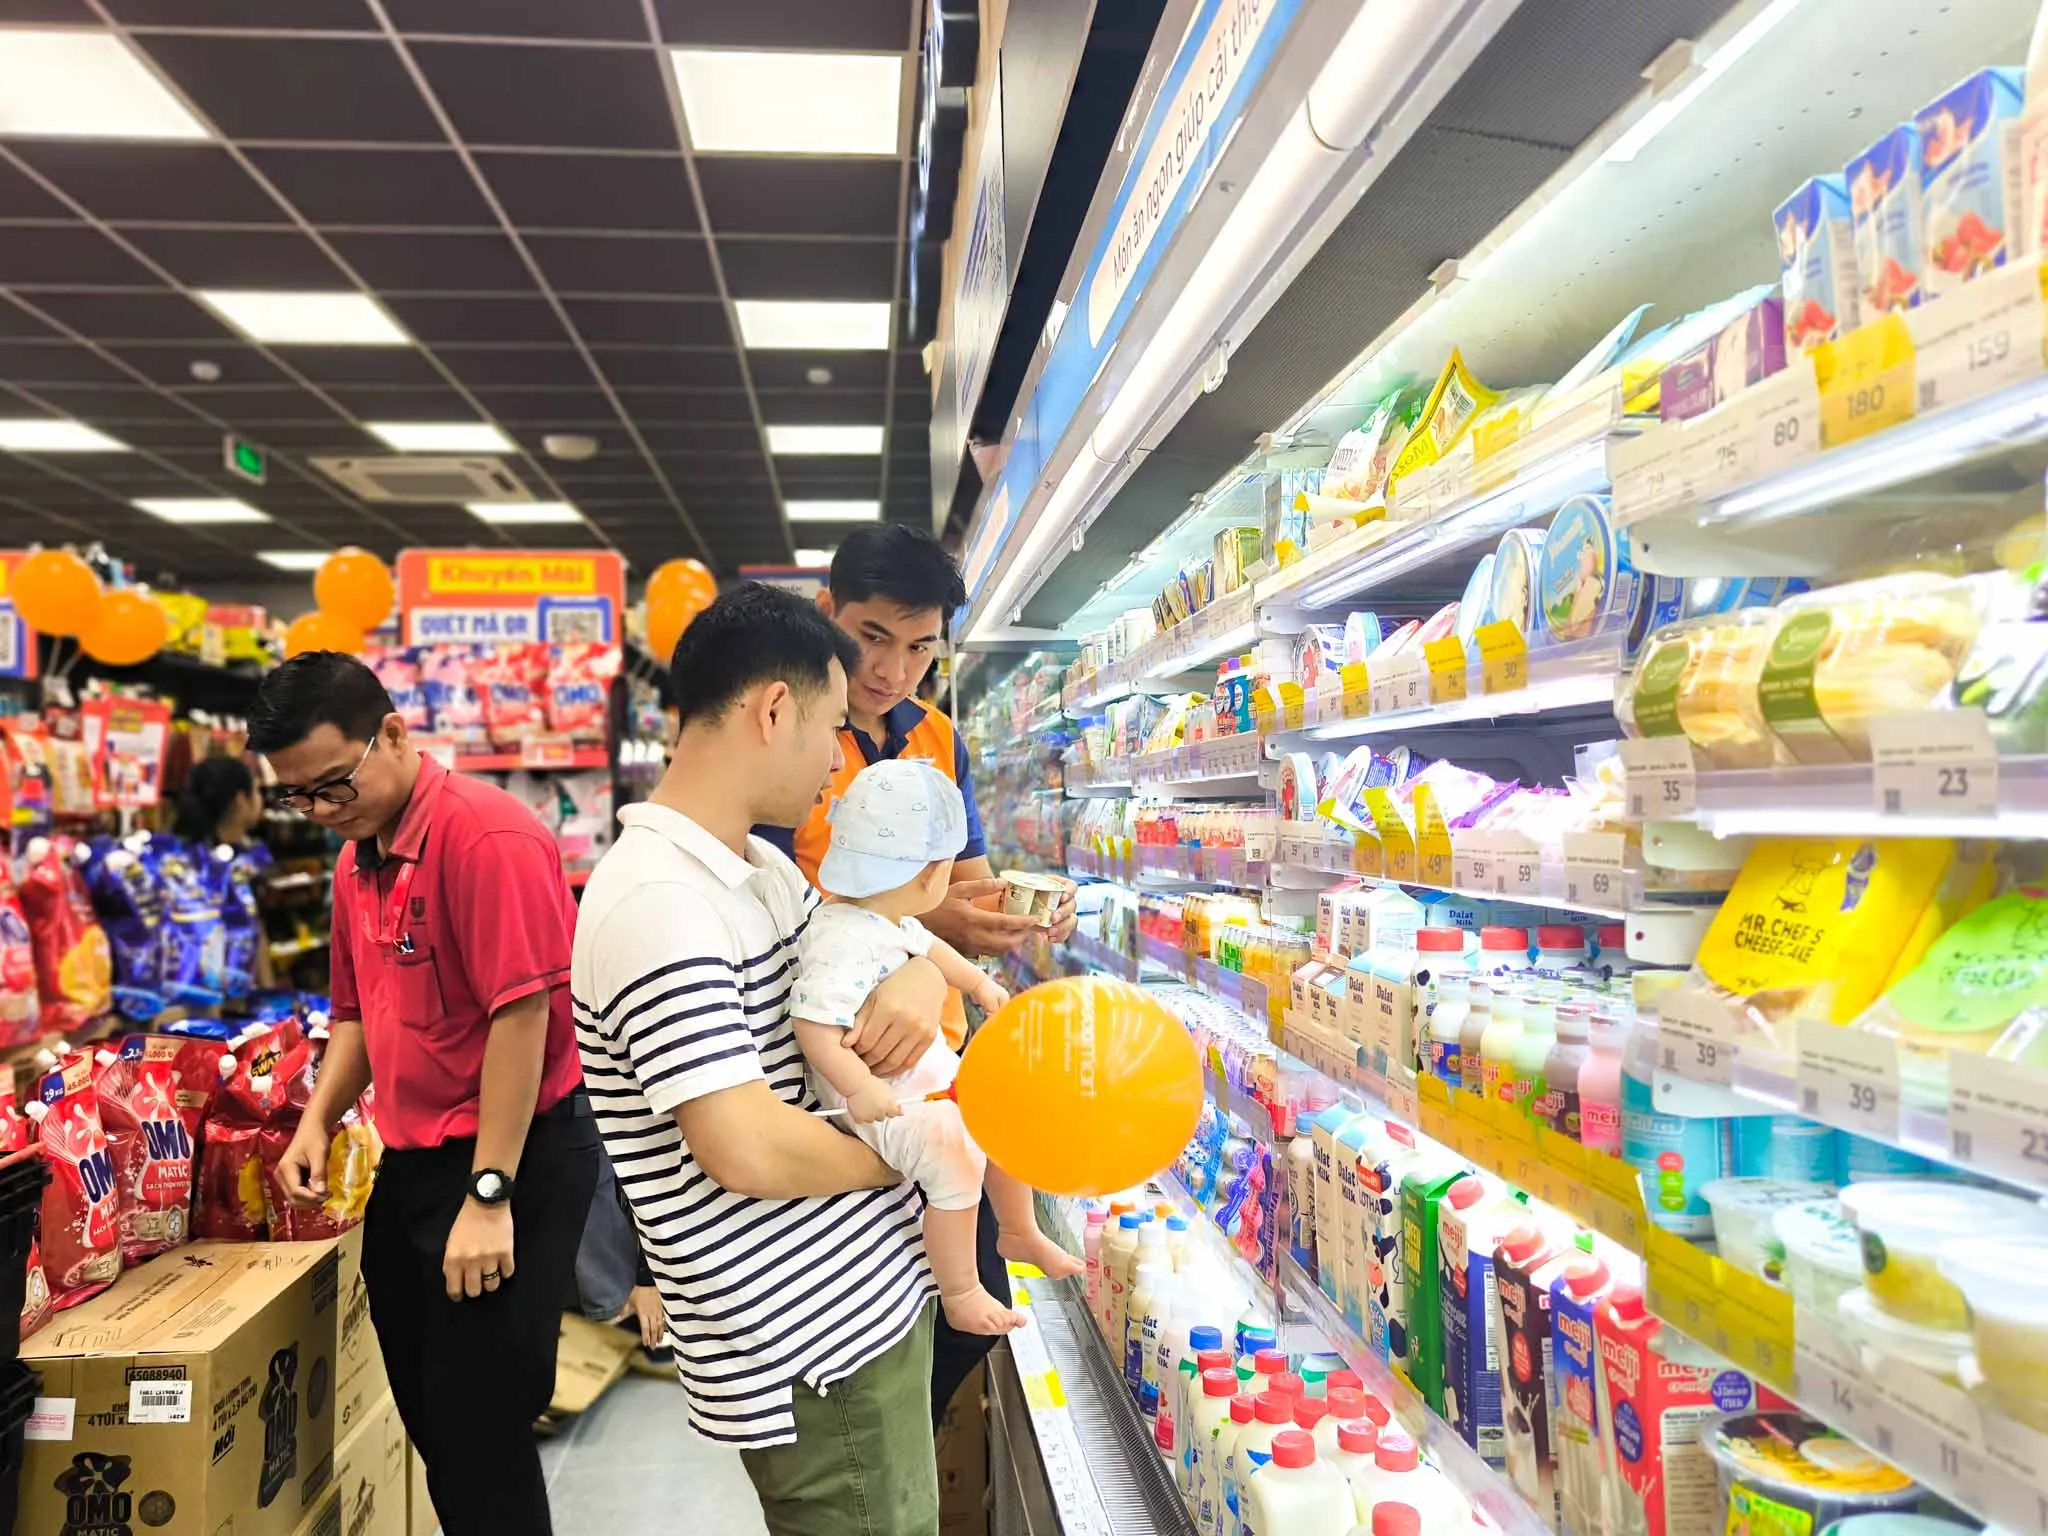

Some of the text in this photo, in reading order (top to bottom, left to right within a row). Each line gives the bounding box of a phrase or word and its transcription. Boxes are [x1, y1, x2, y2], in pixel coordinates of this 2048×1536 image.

[1133, 211, 1145, 249] ăn
[1146, 151, 1174, 219] ngon
[1176, 90, 1205, 174] giúp
[1967, 329, 2011, 371] 159
[1846, 384, 1885, 421] 180
[1773, 416, 1800, 448] 80
[1503, 660, 1518, 680] 30
[1408, 681, 1417, 697] 81
[1662, 780, 1681, 802] 35
[1938, 767, 1969, 797] 23
[1393, 850, 1406, 870] 49
[1427, 854, 1442, 875] 49
[1473, 861, 1485, 879] 59
[1518, 863, 1532, 882] 59
[1592, 873, 1610, 894] 69
[1449, 909, 1474, 920] Dalat
[1349, 975, 1364, 993] Dalat
[1376, 984, 1394, 1004] Dalat
[1352, 993, 1364, 1005] Milk
[1380, 1003, 1393, 1016] Milk
[1696, 1043, 1717, 1066] 39
[1849, 1082, 1876, 1112] 39
[141, 1119, 191, 1160] OMO
[1312, 1140, 1330, 1168] Dalat
[79, 1149, 118, 1204] OM
[158, 1164, 189, 1180] MATIC
[1317, 1164, 1331, 1184] Milk
[1337, 1159, 1356, 1187] Dalat
[1341, 1184, 1356, 1204] Milk
[1442, 1220, 1464, 1250] meiji
[1499, 1277, 1527, 1315] meiji
[1557, 1311, 1592, 1352] meiji
[1601, 1335, 1641, 1380] meiji
[1830, 1378, 1854, 1412] 14
[88, 1414, 96, 1427] 4
[118, 1416, 124, 1426] x
[67, 1492, 133, 1526] OMO
